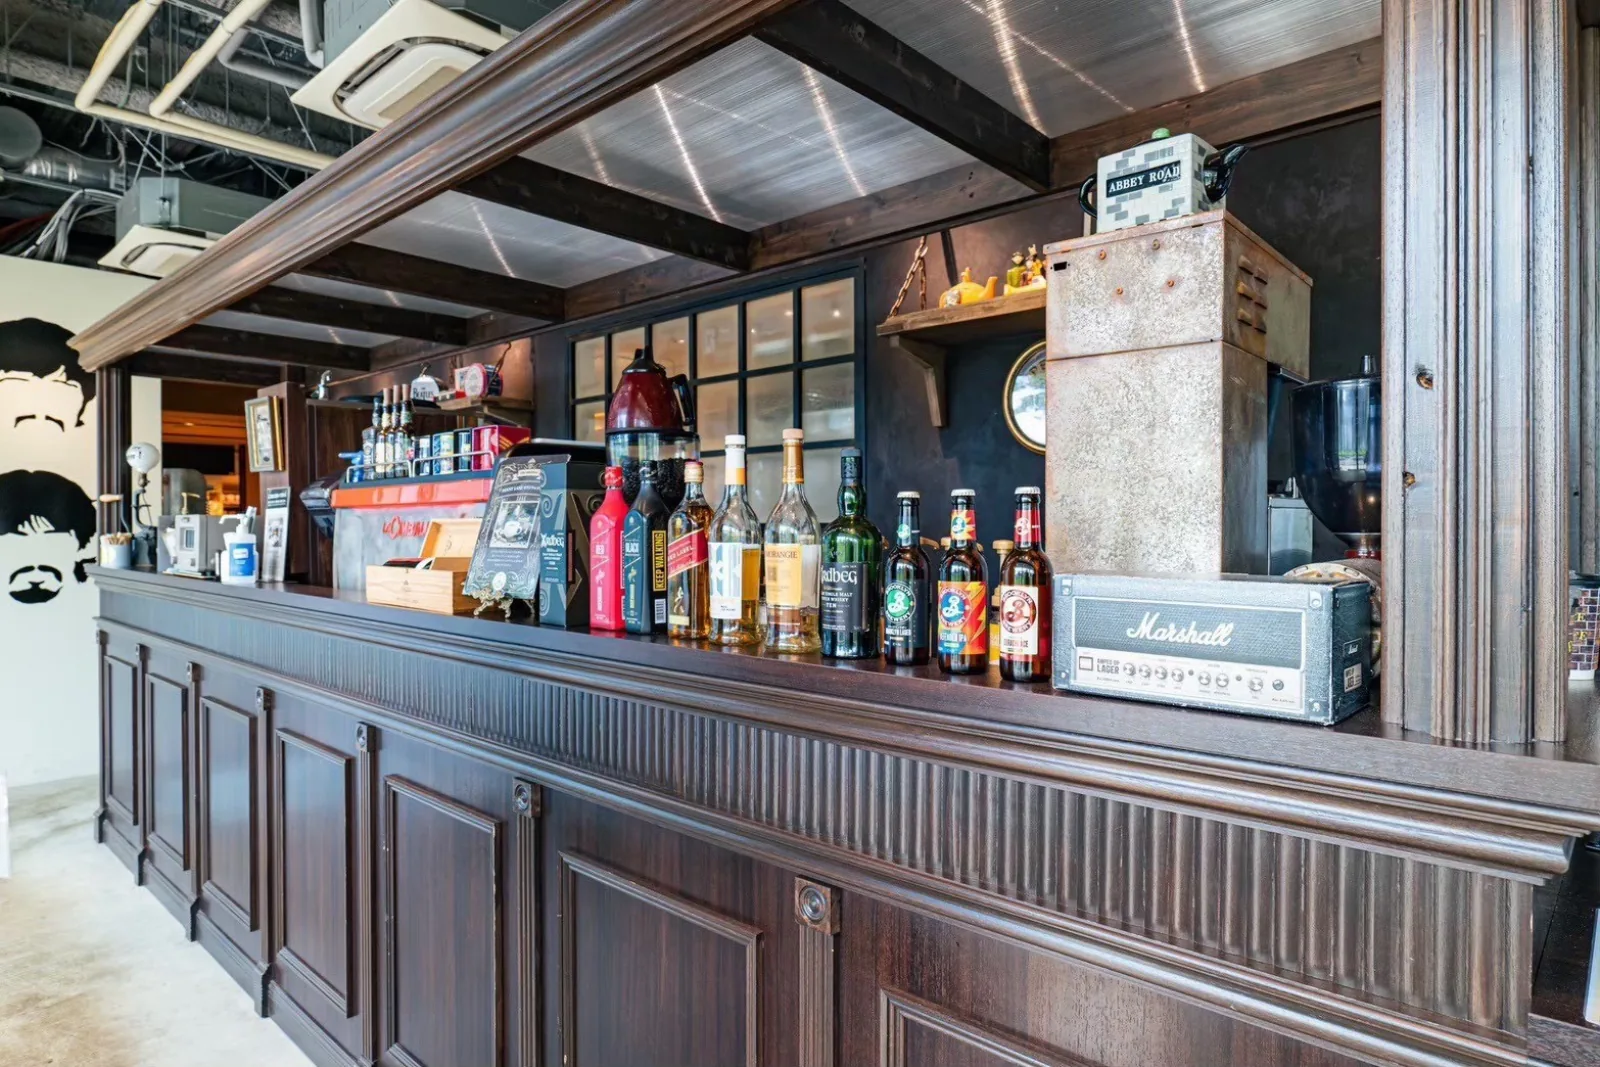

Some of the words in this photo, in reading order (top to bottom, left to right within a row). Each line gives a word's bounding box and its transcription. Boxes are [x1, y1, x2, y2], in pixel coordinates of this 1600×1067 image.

[1108, 175, 1145, 193] ABBEY
[1149, 164, 1180, 183] ROAD
[625, 542, 640, 554] BLACK
[655, 532, 664, 569] WALKING
[676, 545, 693, 557] LABEL
[655, 569, 665, 589] KEEP
[1126, 611, 1235, 647] Marshall
[1096, 664, 1120, 674] LAGER
